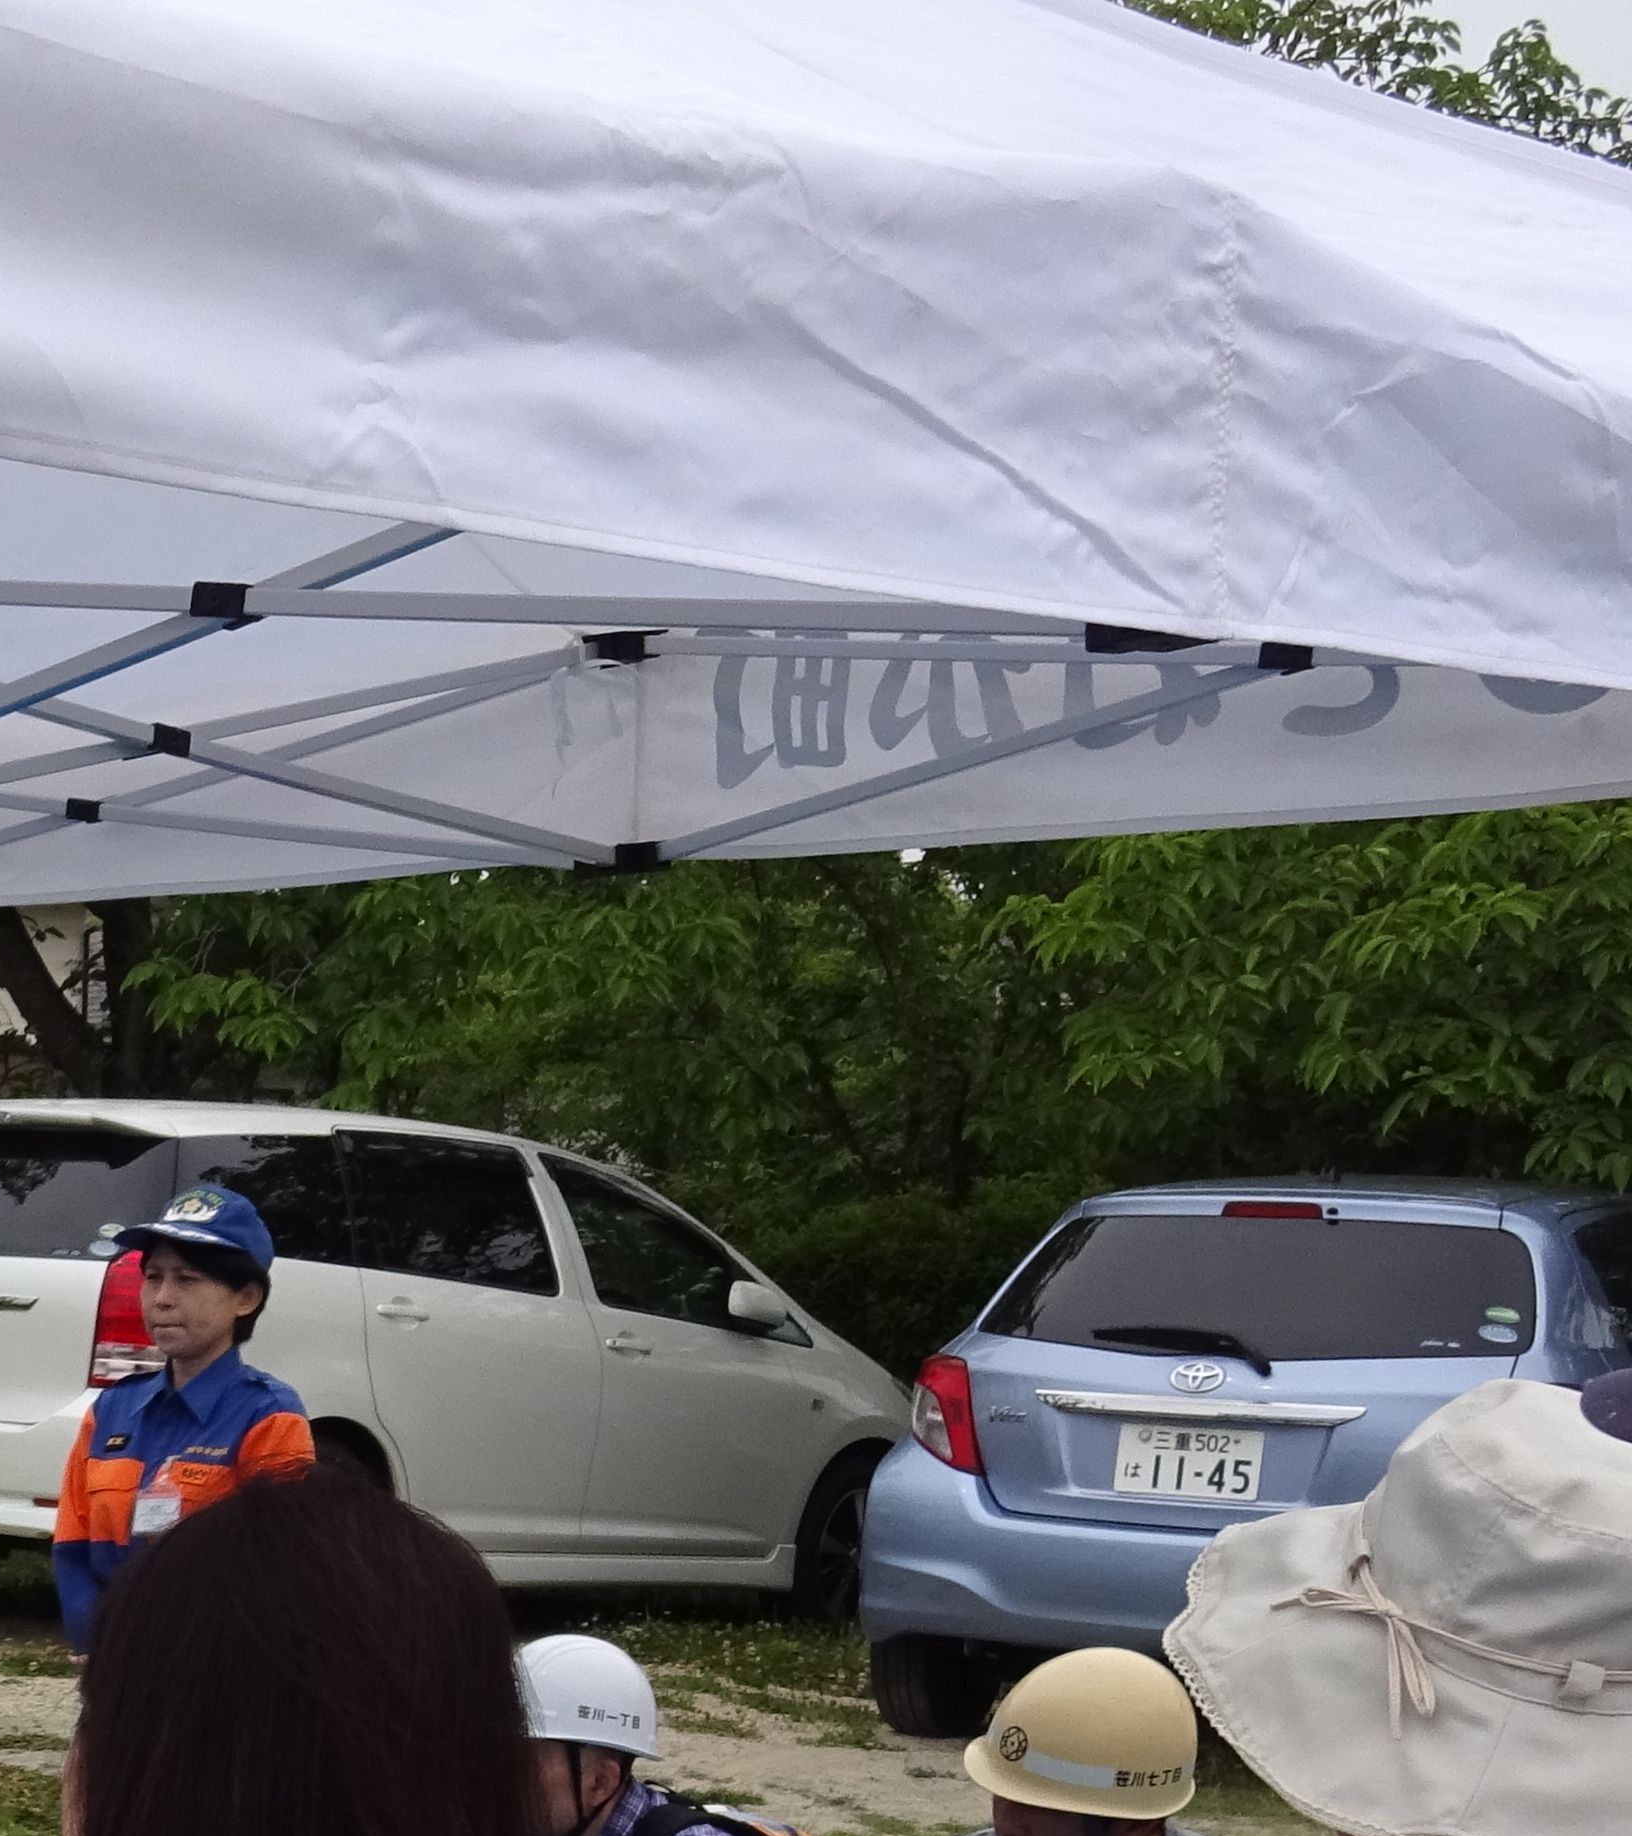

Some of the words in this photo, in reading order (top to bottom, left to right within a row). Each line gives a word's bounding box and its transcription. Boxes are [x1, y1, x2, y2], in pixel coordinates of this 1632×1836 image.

[1152, 1454, 1253, 1495] 11-45
[578, 1704, 641, 1730] 笹川一丁目
[1115, 1767, 1183, 1788] 笹川七丁目
